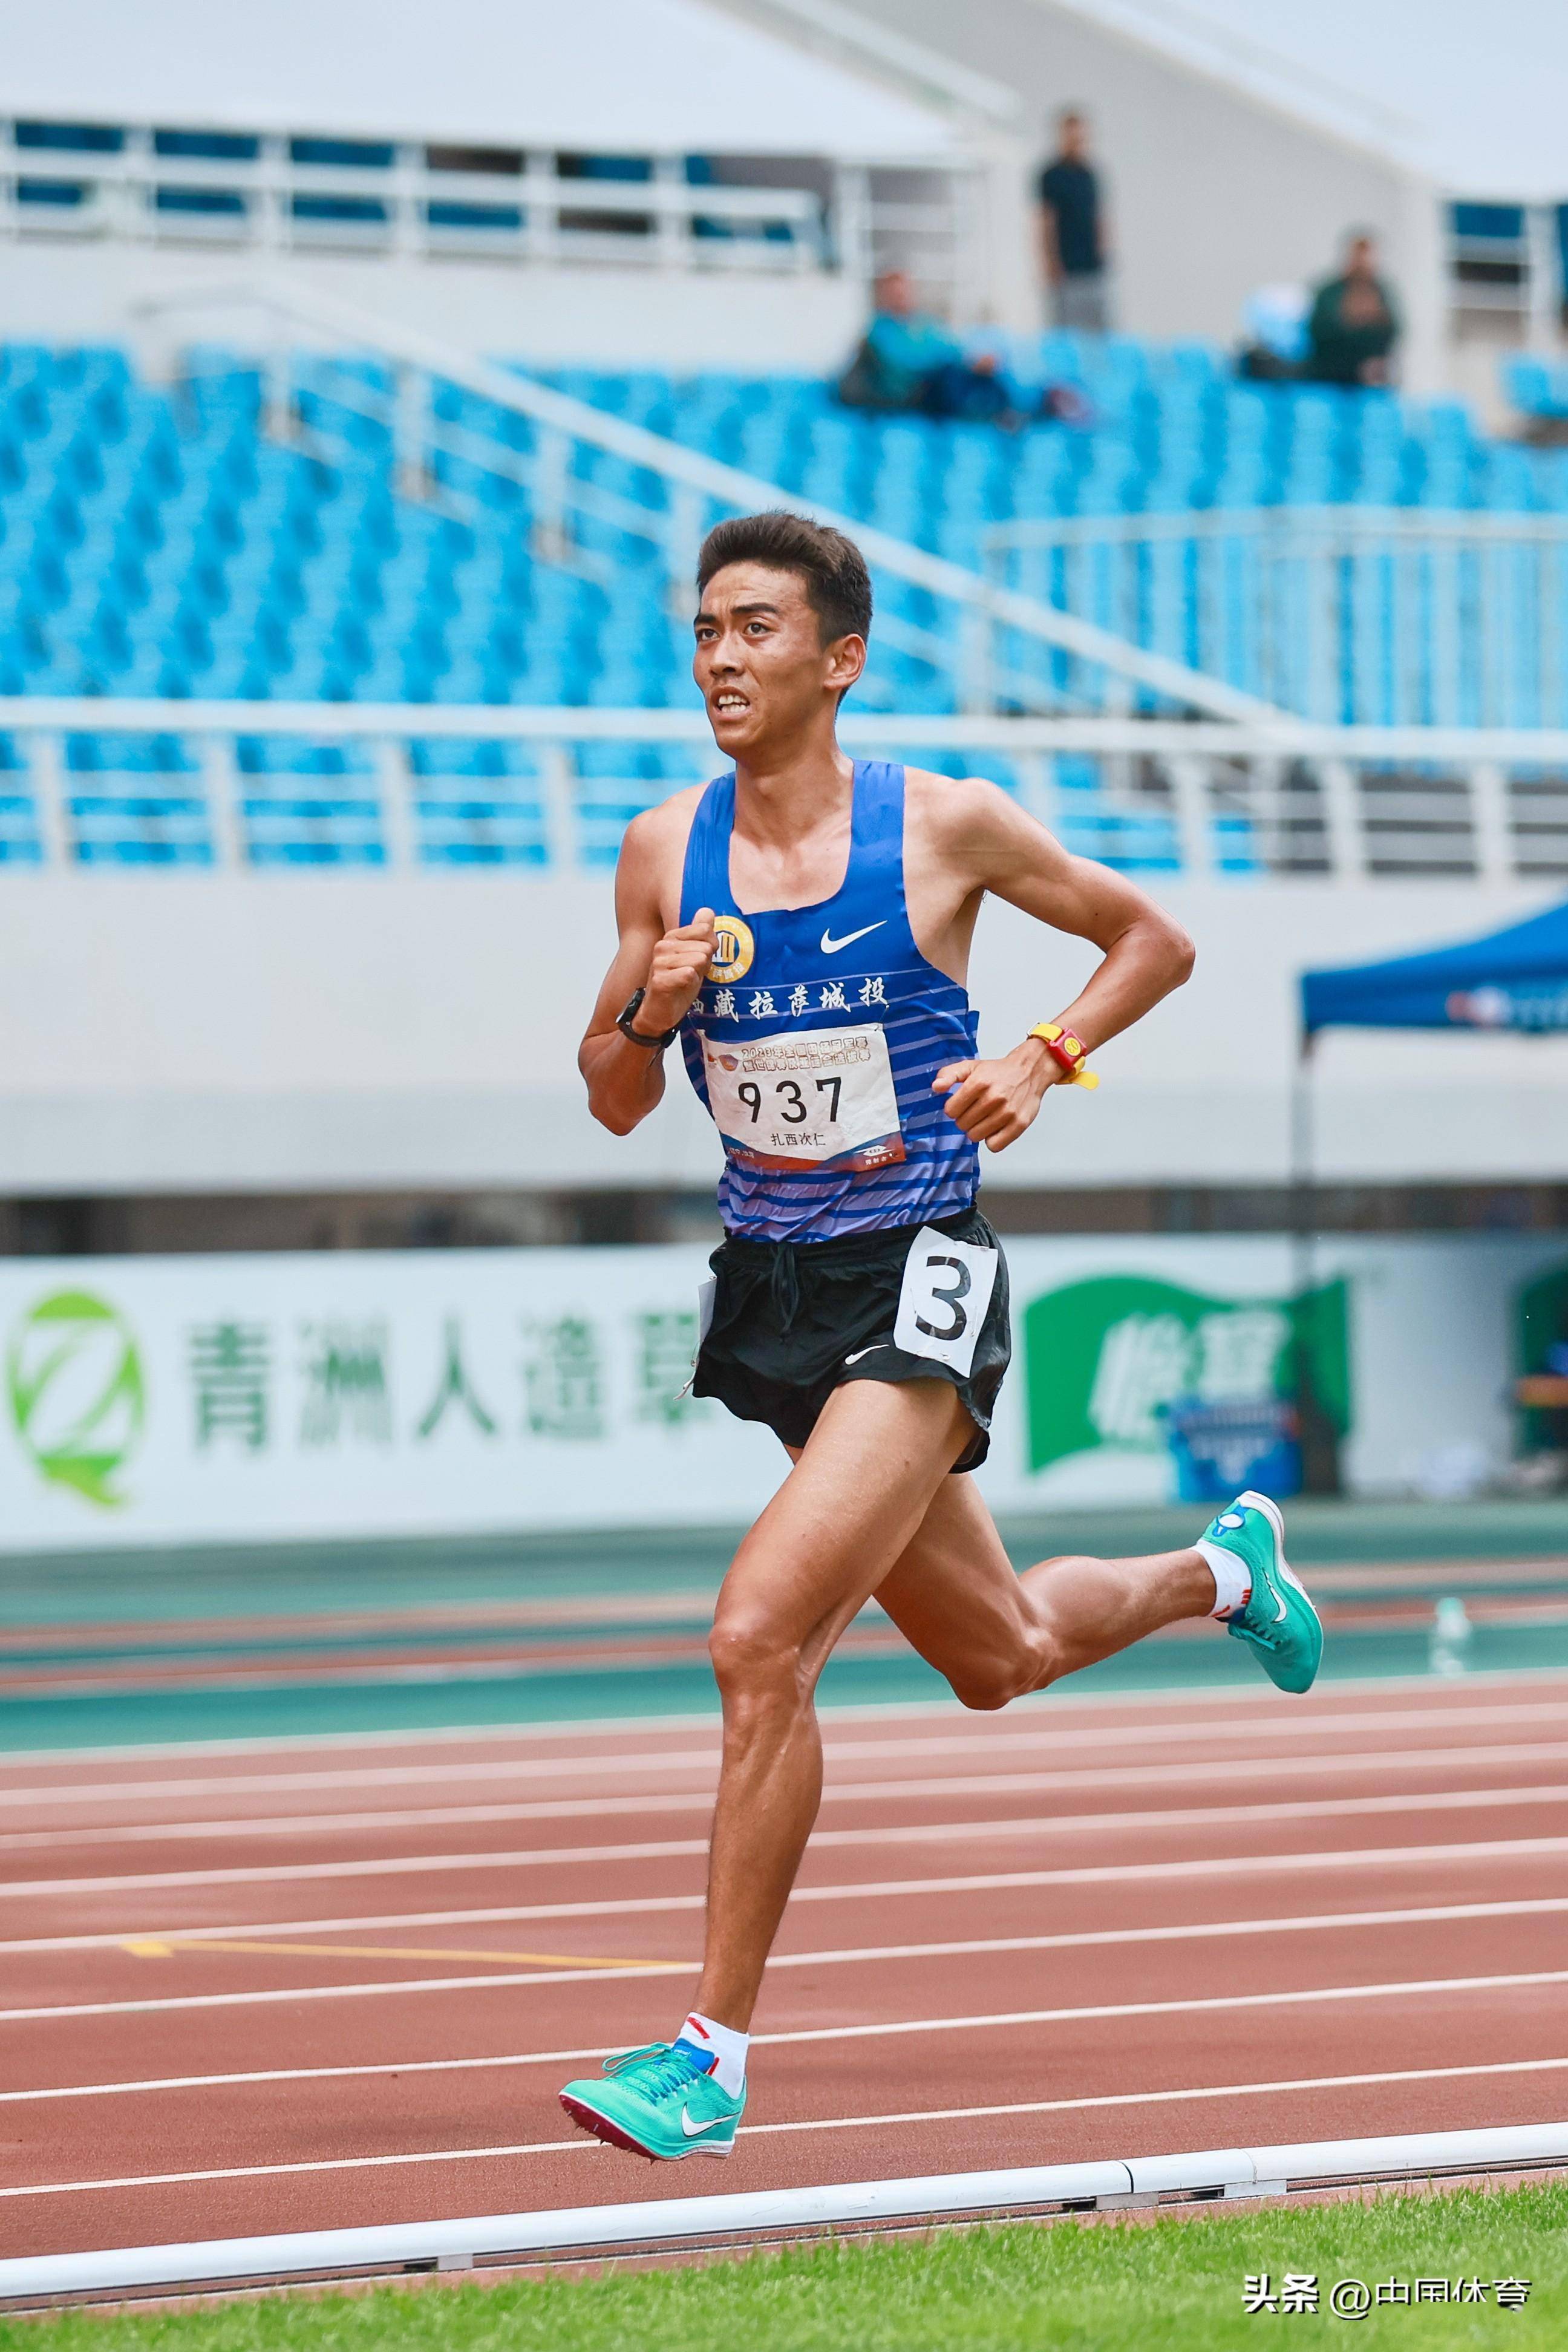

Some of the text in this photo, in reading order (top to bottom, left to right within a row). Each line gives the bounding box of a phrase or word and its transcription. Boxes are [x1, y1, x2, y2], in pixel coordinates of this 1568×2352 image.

[738, 1077, 841, 1123] 937
[770, 1132, 826, 1146] 扎西次仁
[915, 1256, 971, 1341] 3
